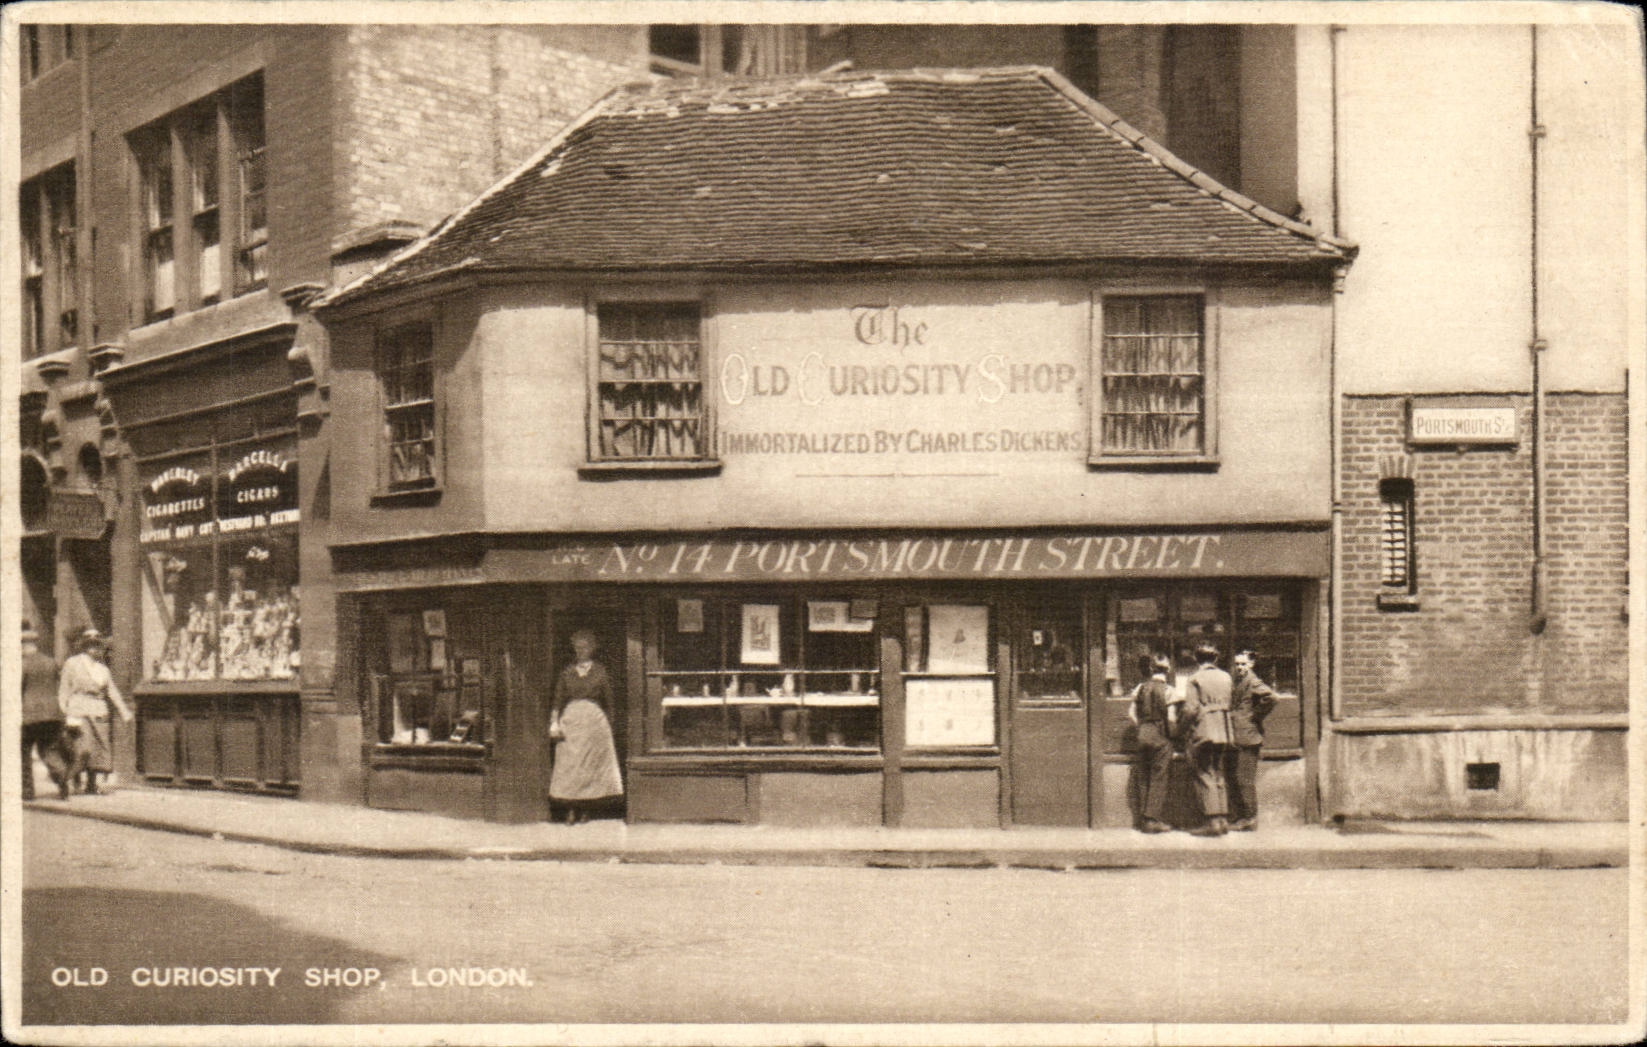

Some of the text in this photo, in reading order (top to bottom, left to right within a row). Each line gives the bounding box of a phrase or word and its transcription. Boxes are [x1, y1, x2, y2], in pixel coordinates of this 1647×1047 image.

[852, 305, 929, 356] The
[719, 352, 790, 405] OLD
[797, 351, 971, 406] CURIOSITY
[1416, 416, 1492, 434] PORTSMOUTH
[721, 428, 1082, 456] IMMORTALIZED BY CHARLES DICKENS
[237, 485, 279, 503] CIGARS
[146, 497, 205, 518] CIGARETTES
[552, 554, 591, 565] LATE
[667, 540, 715, 575] 14
[723, 537, 1034, 574] PORTSMOUTH
